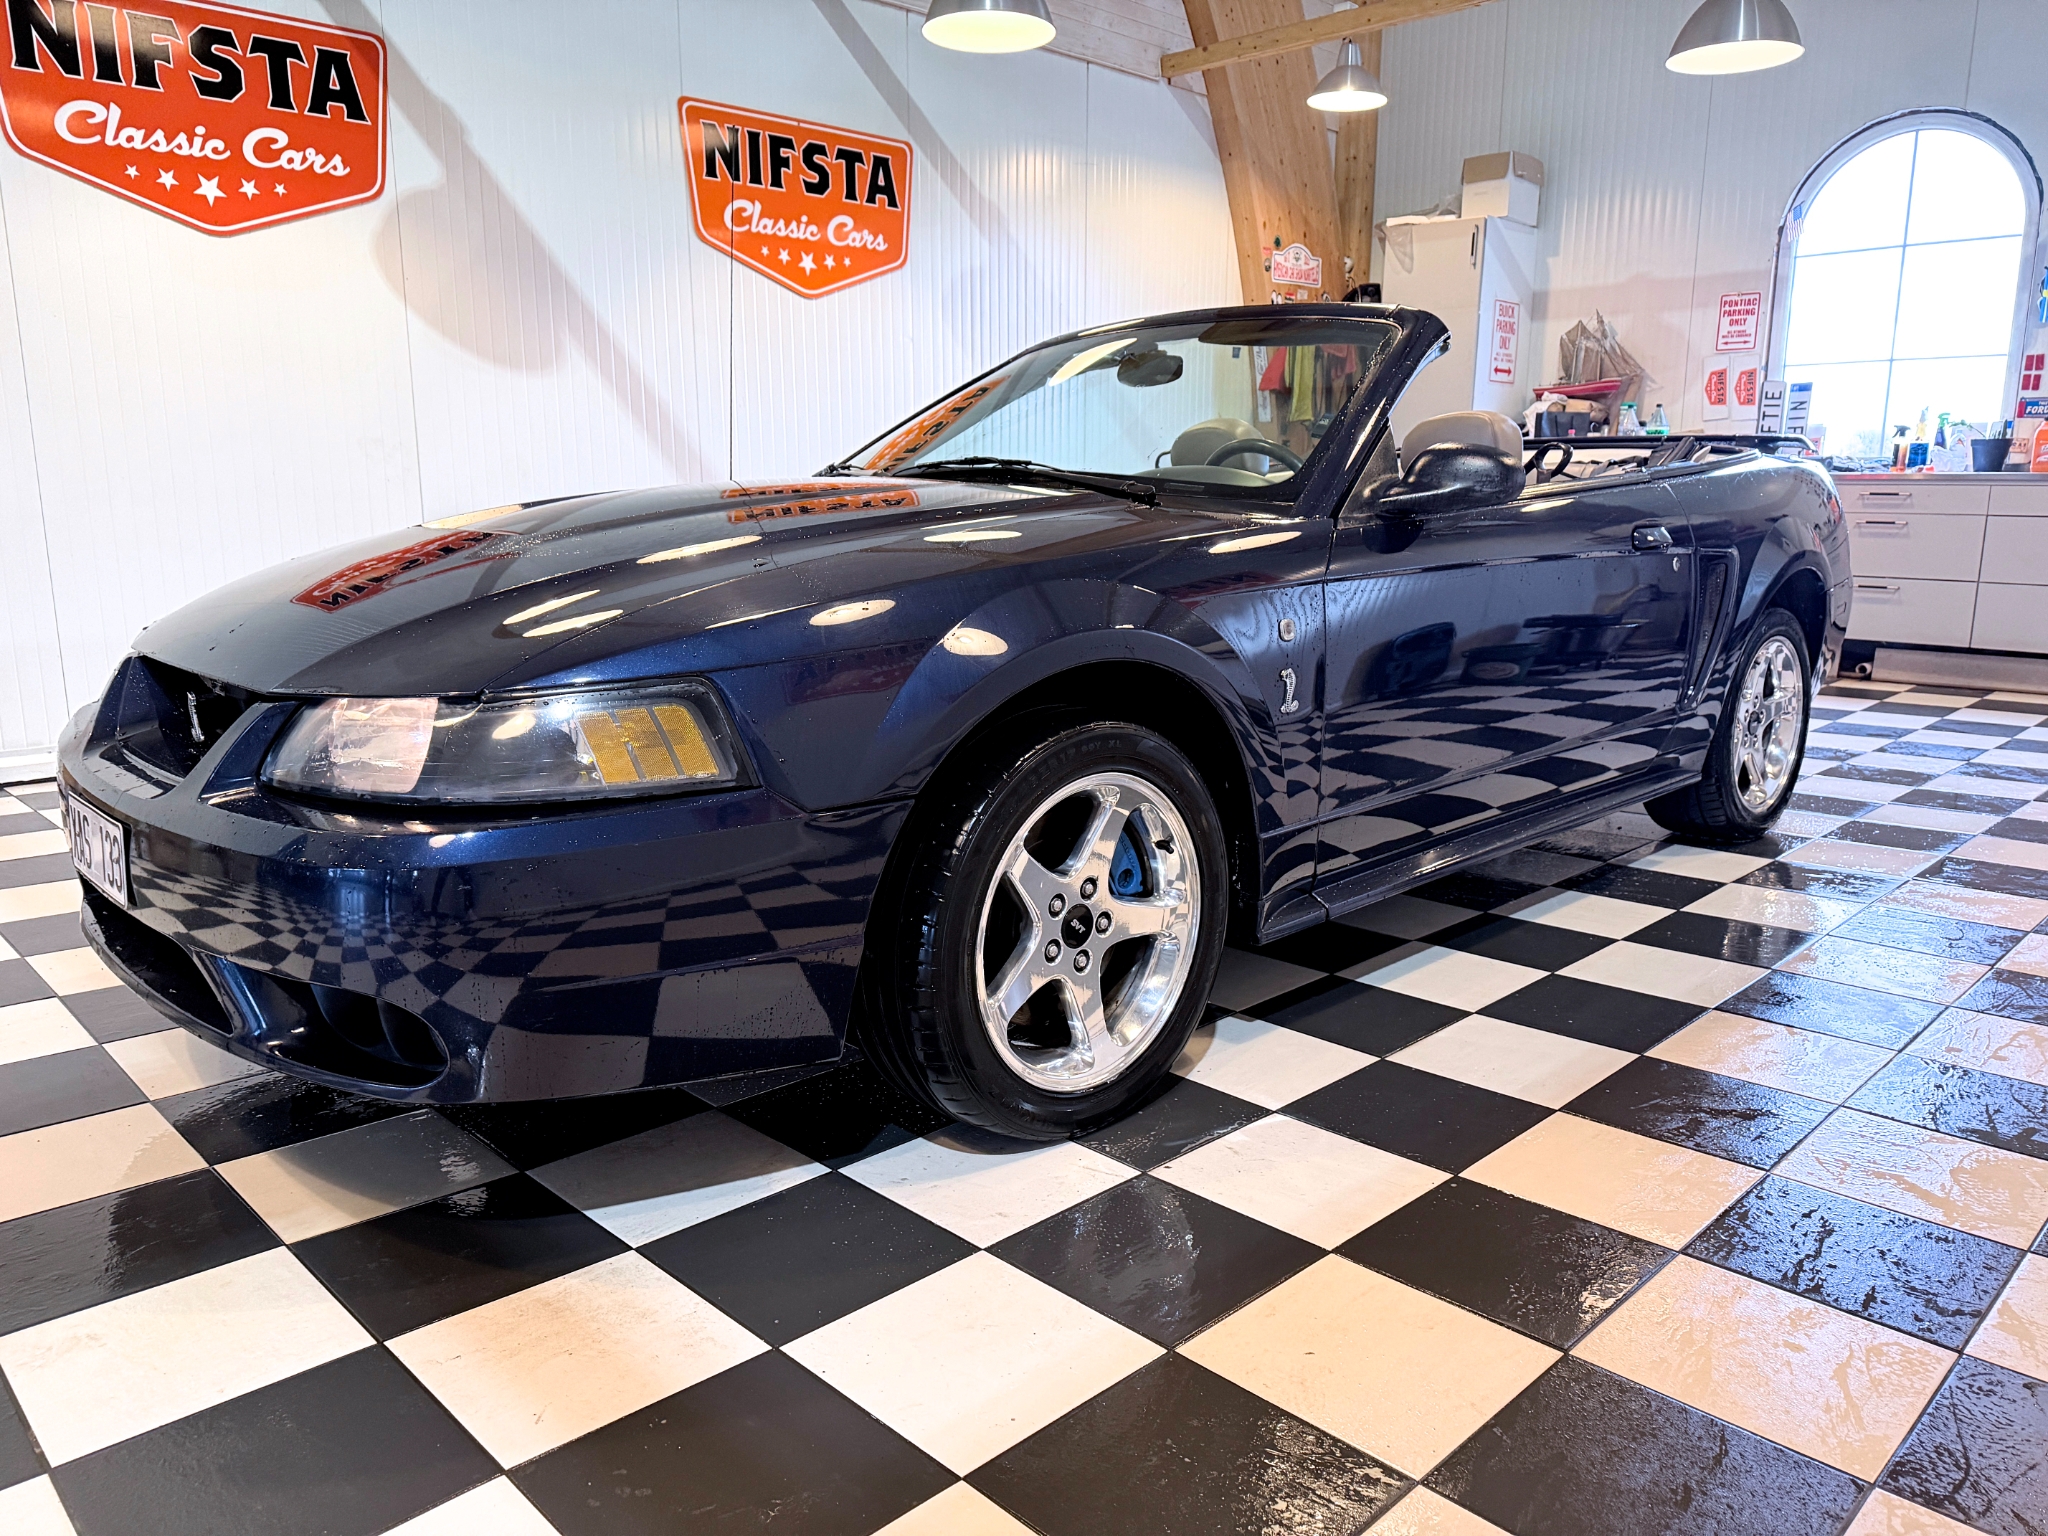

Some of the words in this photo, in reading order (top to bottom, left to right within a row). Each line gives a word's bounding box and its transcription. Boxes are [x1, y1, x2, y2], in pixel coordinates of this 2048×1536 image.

[6, 0, 371, 125] NIFSTA
[54, 100, 231, 161] Classic
[242, 127, 351, 177] Cars
[699, 119, 901, 211] NIFSTA
[723, 198, 821, 241] Classic
[826, 215, 888, 251] Cars
[1499, 304, 1515, 318] BUICK
[1722, 308, 1756, 318] PARKING
[1723, 298, 1757, 308] PONTIAC
[1496, 319, 1516, 335] PARKING
[1728, 317, 1748, 327] ONLY
[1499, 335, 1511, 350] ONLY
[1717, 371, 1725, 404] NIFSTA
[1746, 371, 1754, 404] NIFSTA
[99, 825, 123, 894] 133
[1070, 918, 1086, 934] SVT
